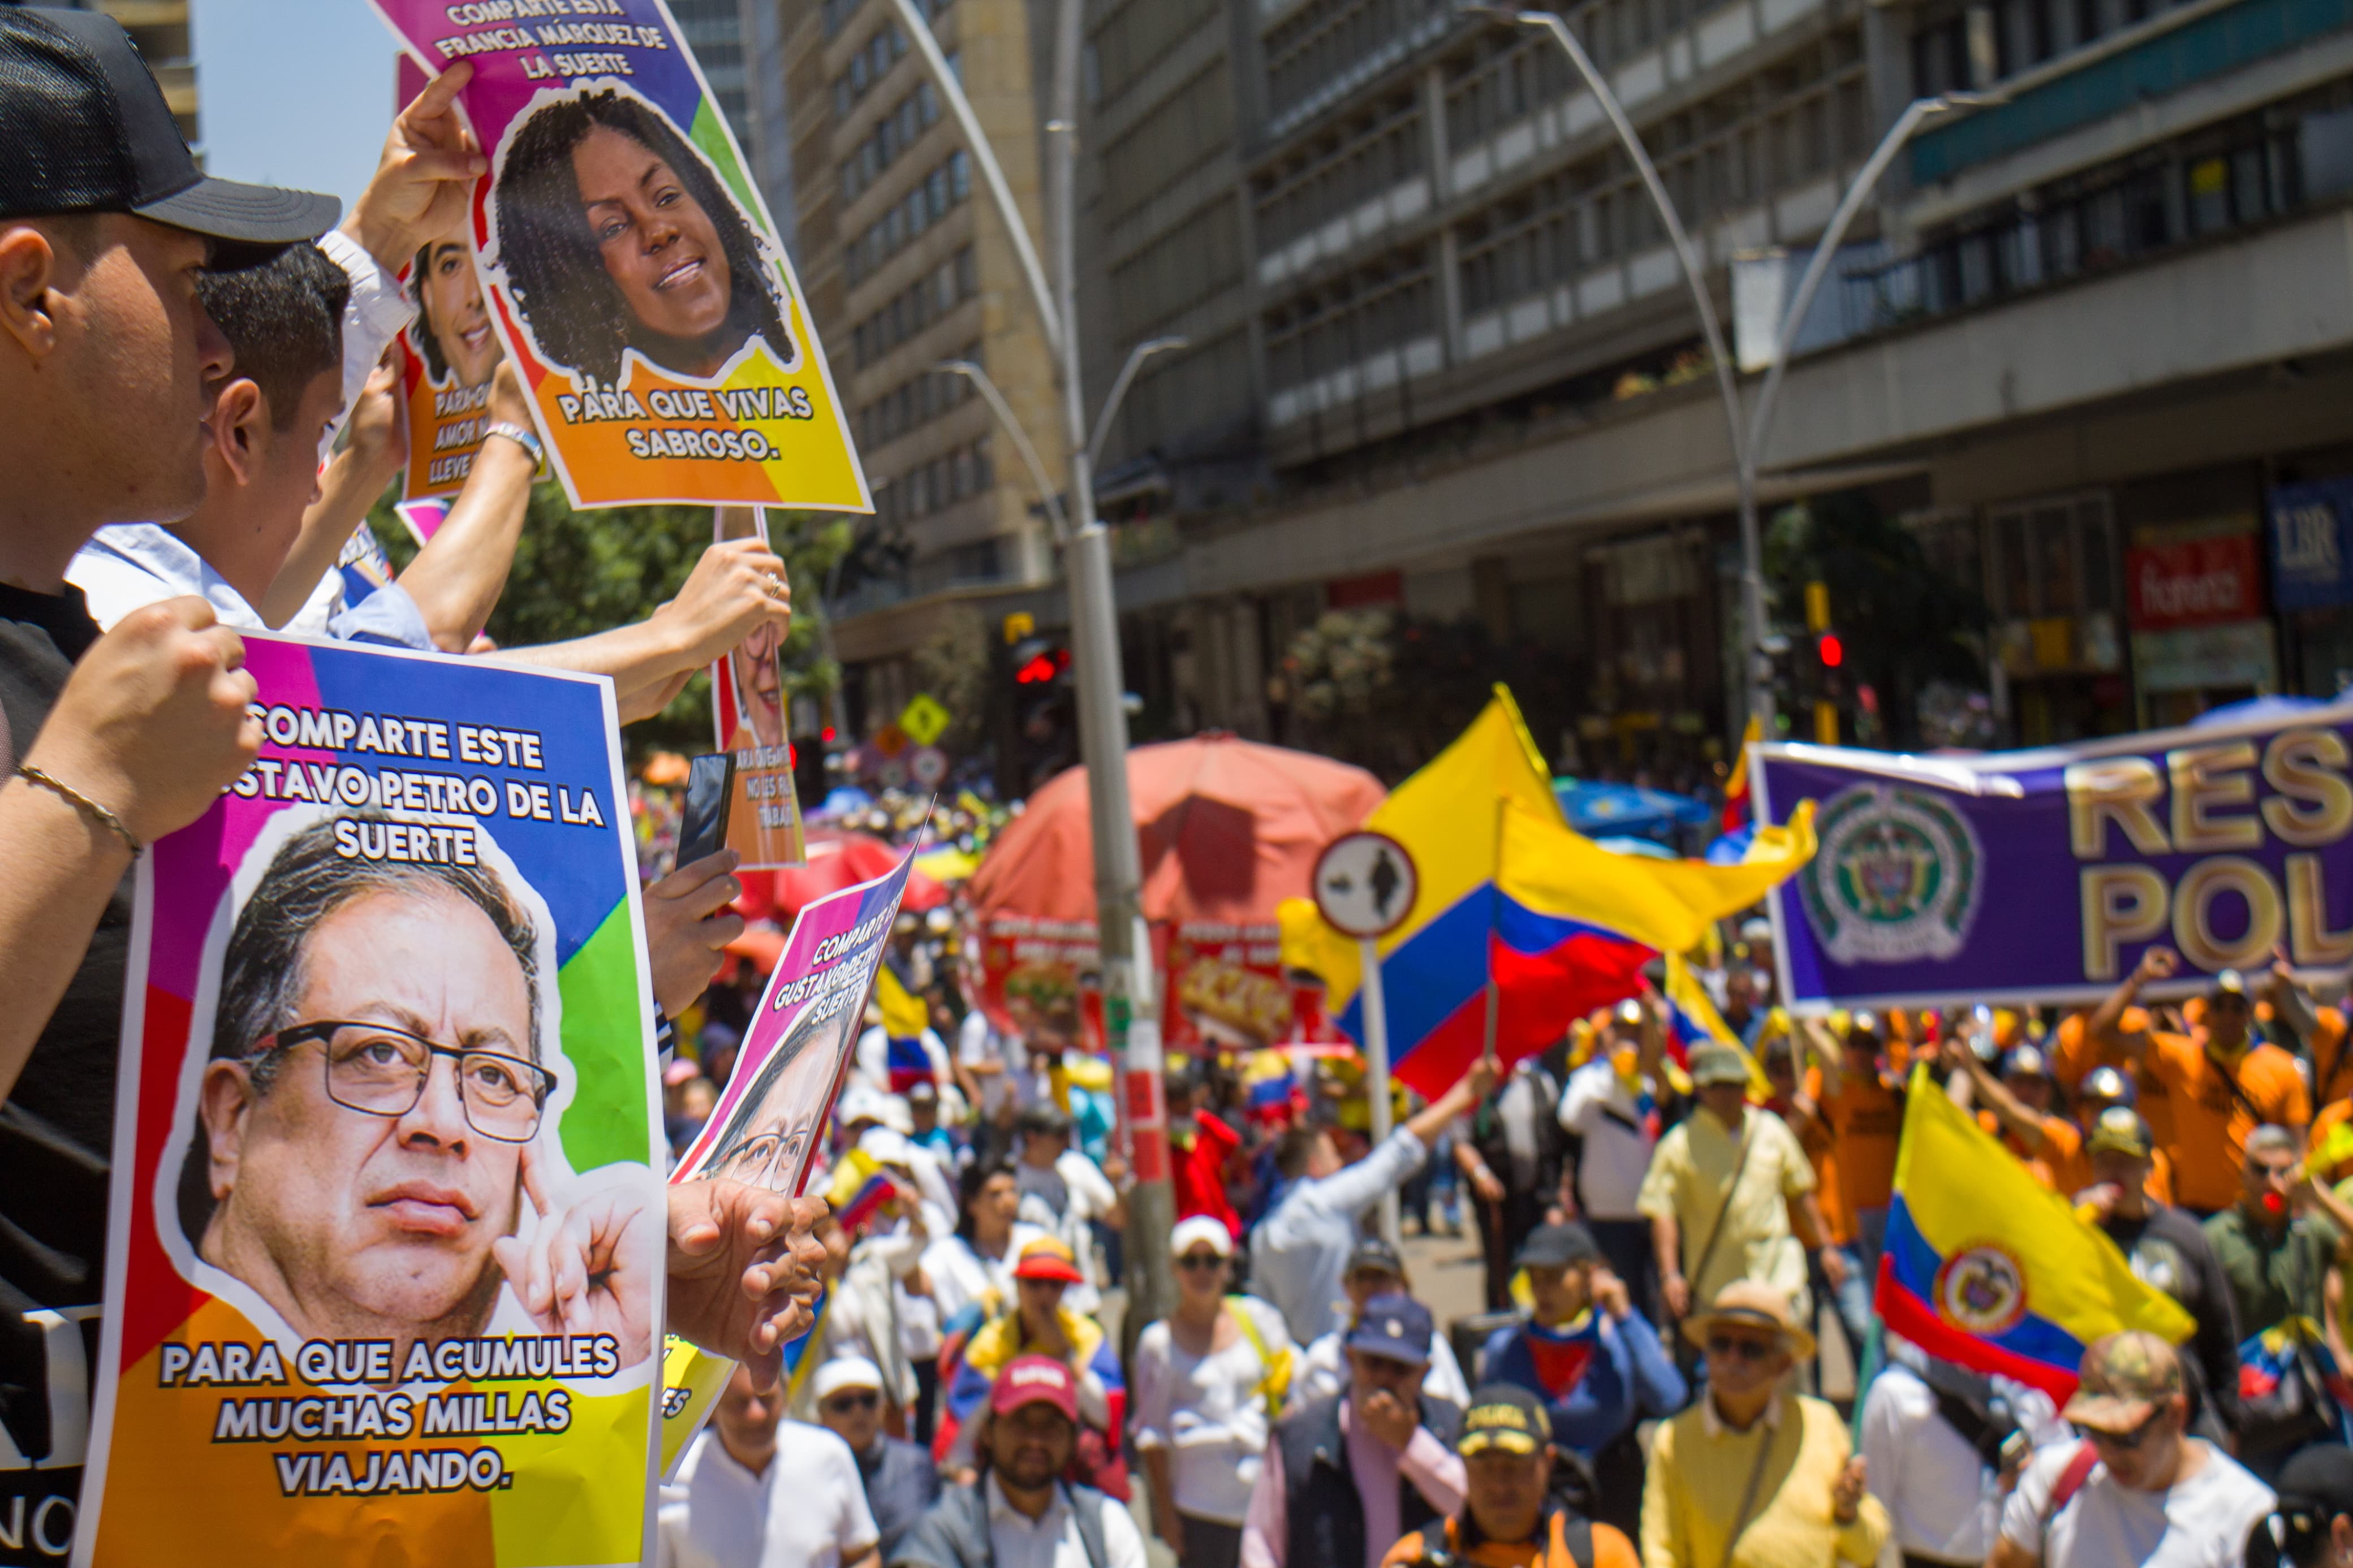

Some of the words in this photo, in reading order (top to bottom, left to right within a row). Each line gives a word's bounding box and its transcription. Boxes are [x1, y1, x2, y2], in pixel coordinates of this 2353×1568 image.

[446, 0, 571, 26] COMPARTE
[569, 0, 626, 16] ESTA
[433, 25, 538, 59] FRANCIA
[539, 19, 639, 48] MÁRQUEZ
[639, 25, 669, 50] DE
[519, 55, 555, 79] LA
[553, 53, 634, 77] SUERTE
[557, 390, 649, 424] PARA
[648, 388, 715, 420] QUE
[716, 386, 813, 421] VIVAS
[434, 420, 476, 453] AMOR
[625, 429, 782, 461] SABROSO.
[456, 723, 545, 771] ESTE
[736, 748, 755, 771] ARA
[221, 757, 371, 806] STAVO
[378, 766, 499, 817] PETRO
[505, 778, 553, 823] DE
[557, 784, 607, 828] LA
[2063, 726, 2353, 859] RES
[333, 817, 477, 867] SUERTE
[812, 905, 888, 966] COMPARTE
[2079, 853, 2353, 982] POL
[773, 961, 847, 1012] GUSTAVO
[811, 979, 862, 1025] SUERTE
[159, 1340, 288, 1388] PARA
[296, 1338, 391, 1385] QUE
[398, 1333, 619, 1385] ACUMULES
[212, 1392, 413, 1443] MUCHAS
[420, 1389, 572, 1439] MILLAS
[273, 1446, 514, 1497] VIAJANDO.
